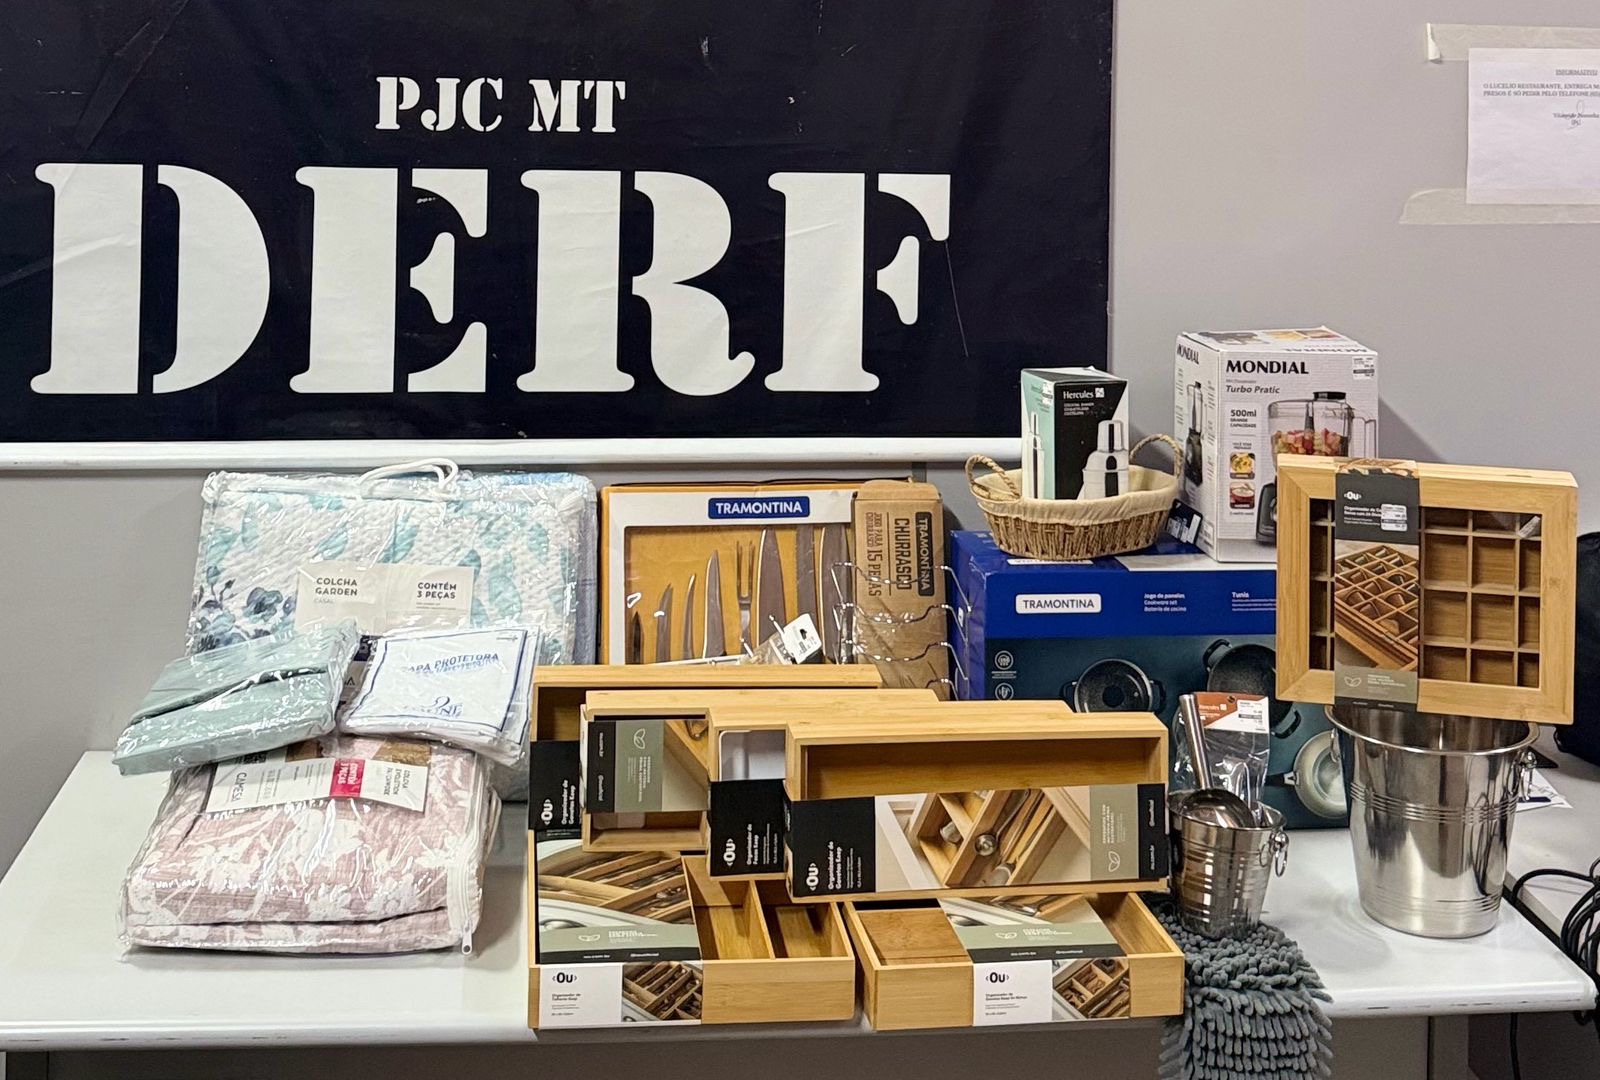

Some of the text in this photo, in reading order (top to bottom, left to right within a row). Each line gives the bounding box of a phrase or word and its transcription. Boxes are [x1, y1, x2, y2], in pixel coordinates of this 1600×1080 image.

[375, 76, 626, 133] PJC MT
[29, 162, 952, 396] DERF
[1176, 344, 1199, 365] MONDIAL
[1226, 360, 1309, 374] MONDIAL
[1063, 390, 1094, 399] Hercules
[1226, 385, 1280, 394] Turbo Pratic
[716, 502, 803, 514] TRAMONTINA
[867, 549, 882, 562] 15
[894, 518, 912, 590] CHURRASCO
[316, 578, 358, 586] COLCHA
[418, 581, 457, 590] CONTÉM
[867, 564, 882, 596] PEAS
[315, 587, 358, 596] GARDEN
[426, 591, 456, 600] PEÇAS
[1022, 599, 1094, 610] TRAMONTINA
[231, 772, 247, 802] CAMESA
